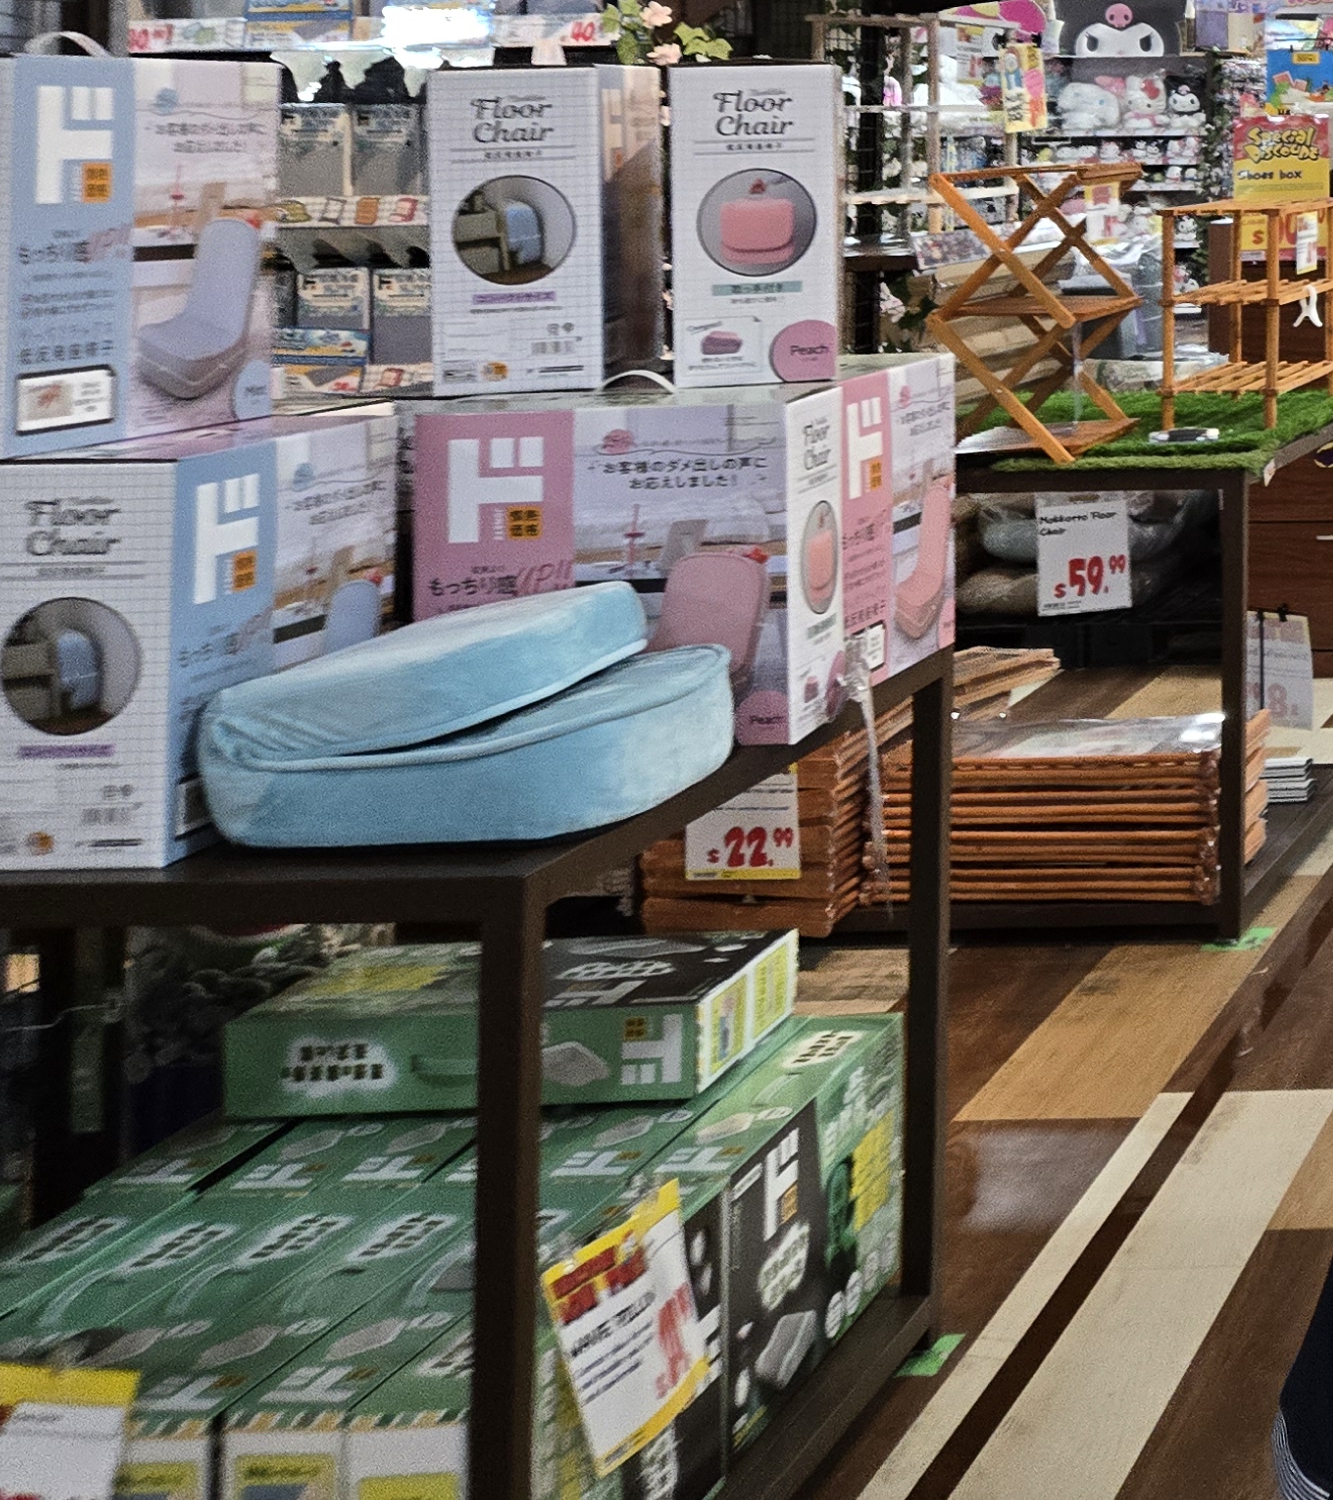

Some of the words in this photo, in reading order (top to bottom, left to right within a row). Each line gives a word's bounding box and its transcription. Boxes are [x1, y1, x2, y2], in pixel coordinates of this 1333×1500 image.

[470, 97, 554, 120] Floor
[713, 89, 793, 114] Floor
[472, 120, 554, 144] Chair
[715, 113, 795, 138] Chair
[1247, 126, 1317, 147] Special
[1237, 169, 1275, 180] Shoes
[1279, 168, 1303, 180] box
[789, 342, 829, 358] Peach
[1039, 527, 1067, 537] Chair
[749, 713, 785, 727] Peach
